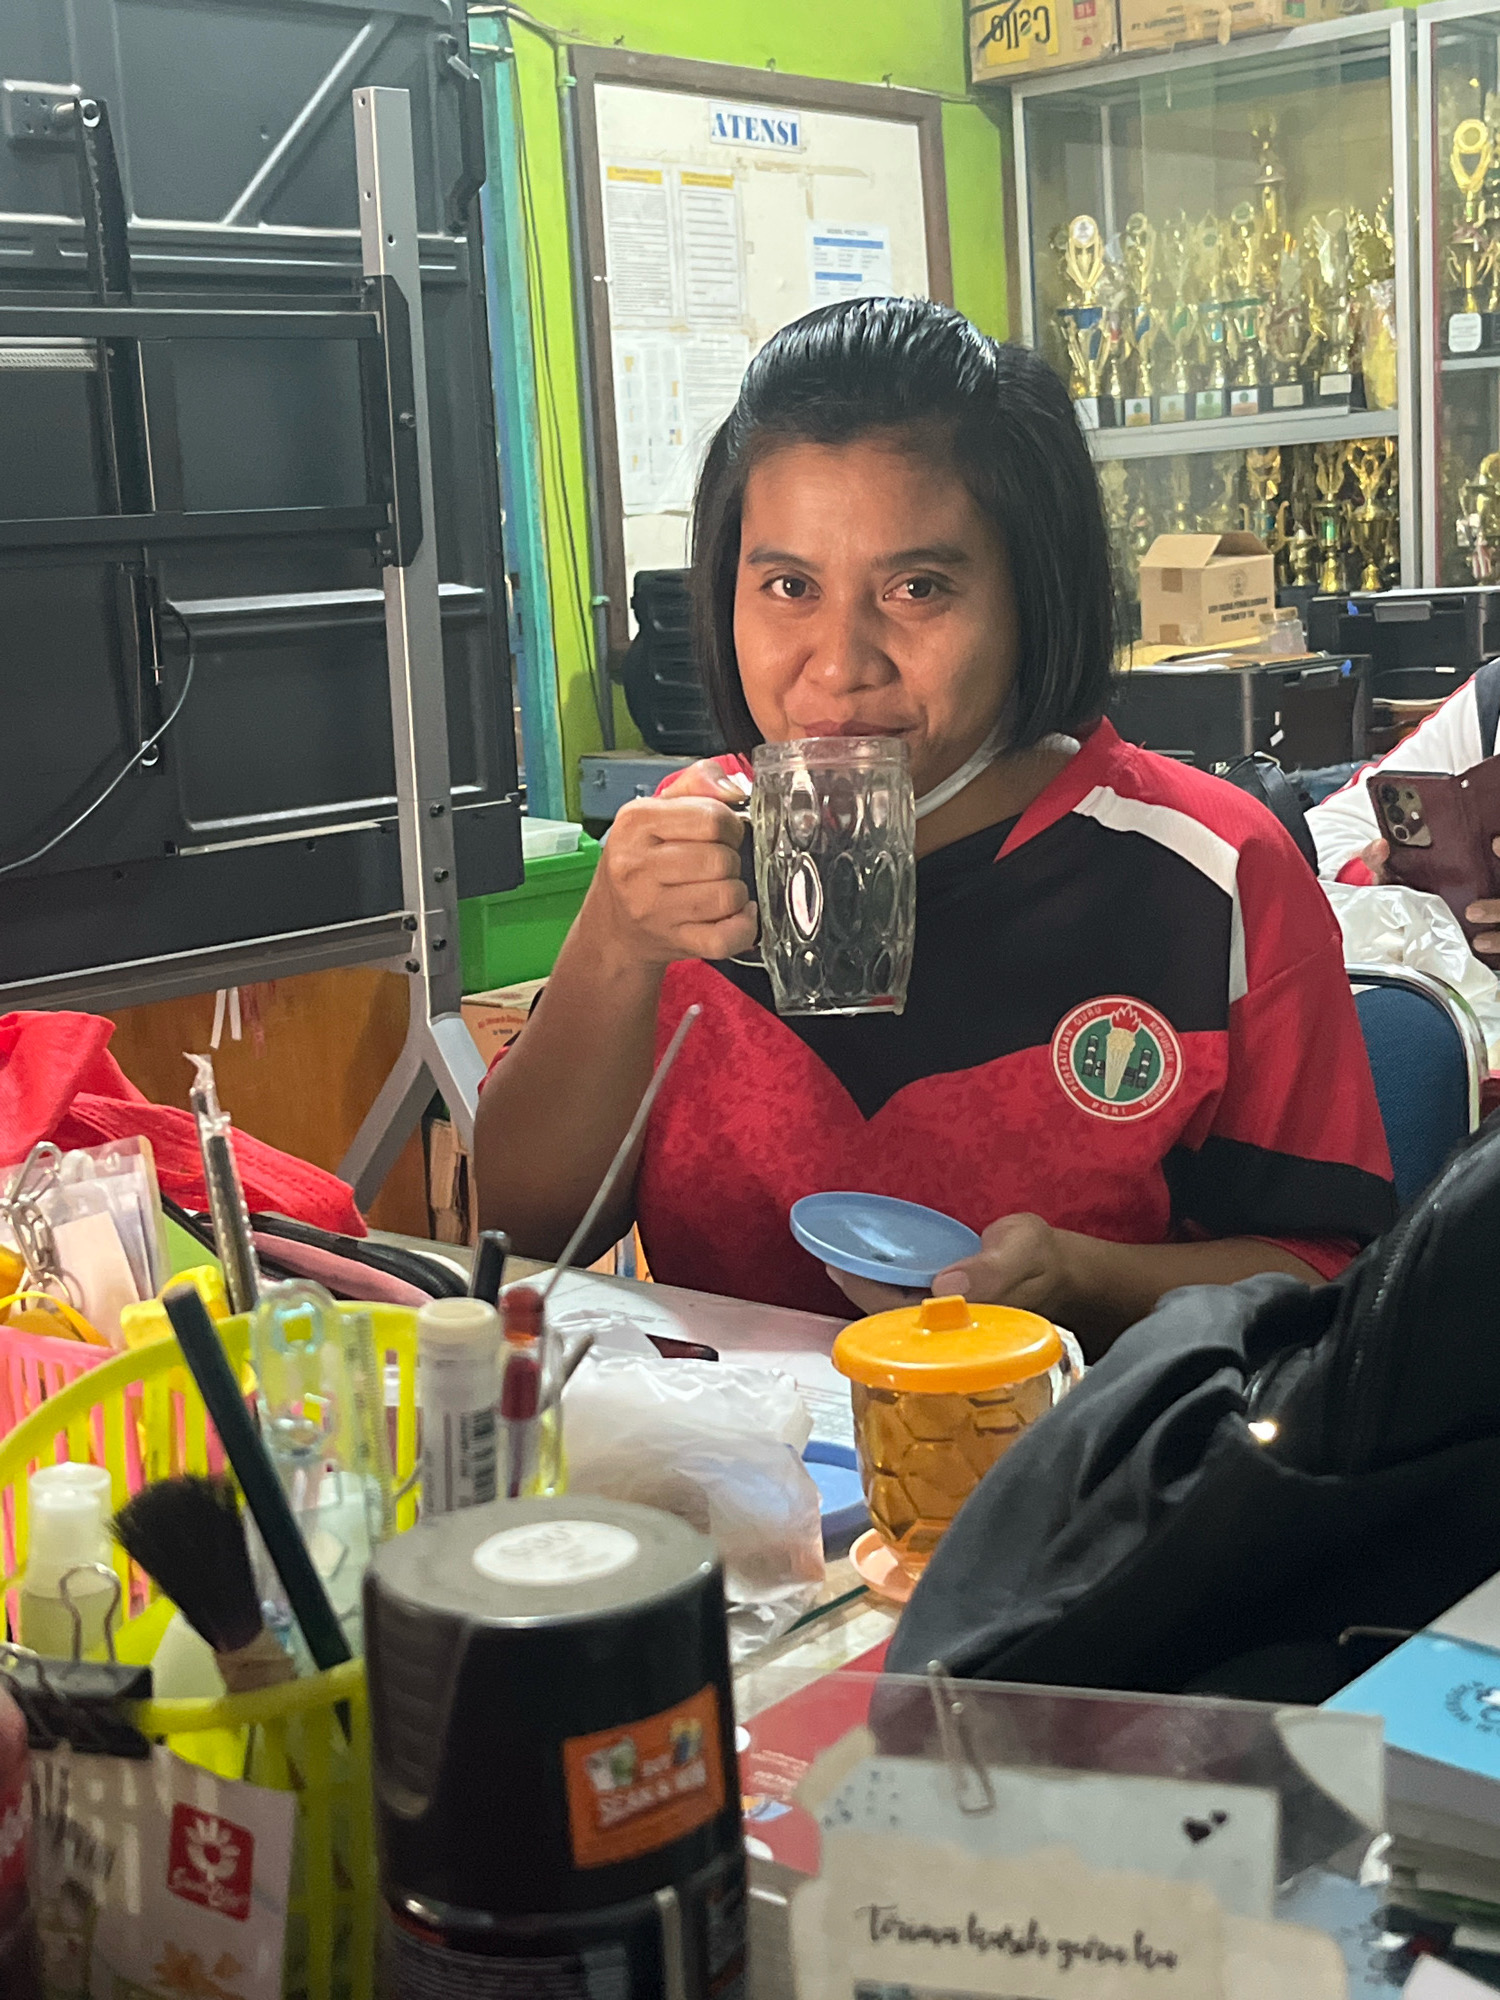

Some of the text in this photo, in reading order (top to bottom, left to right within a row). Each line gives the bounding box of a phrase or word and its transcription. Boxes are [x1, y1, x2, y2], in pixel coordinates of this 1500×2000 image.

[991, 5, 1051, 50] Cello
[711, 112, 798, 146] ATENSI
[1059, 1031, 1079, 1092] PERSATUAN
[1073, 1006, 1102, 1026] GURU
[1149, 1020, 1176, 1064] REPUBLIK
[1091, 1101, 1127, 1116] PGRI
